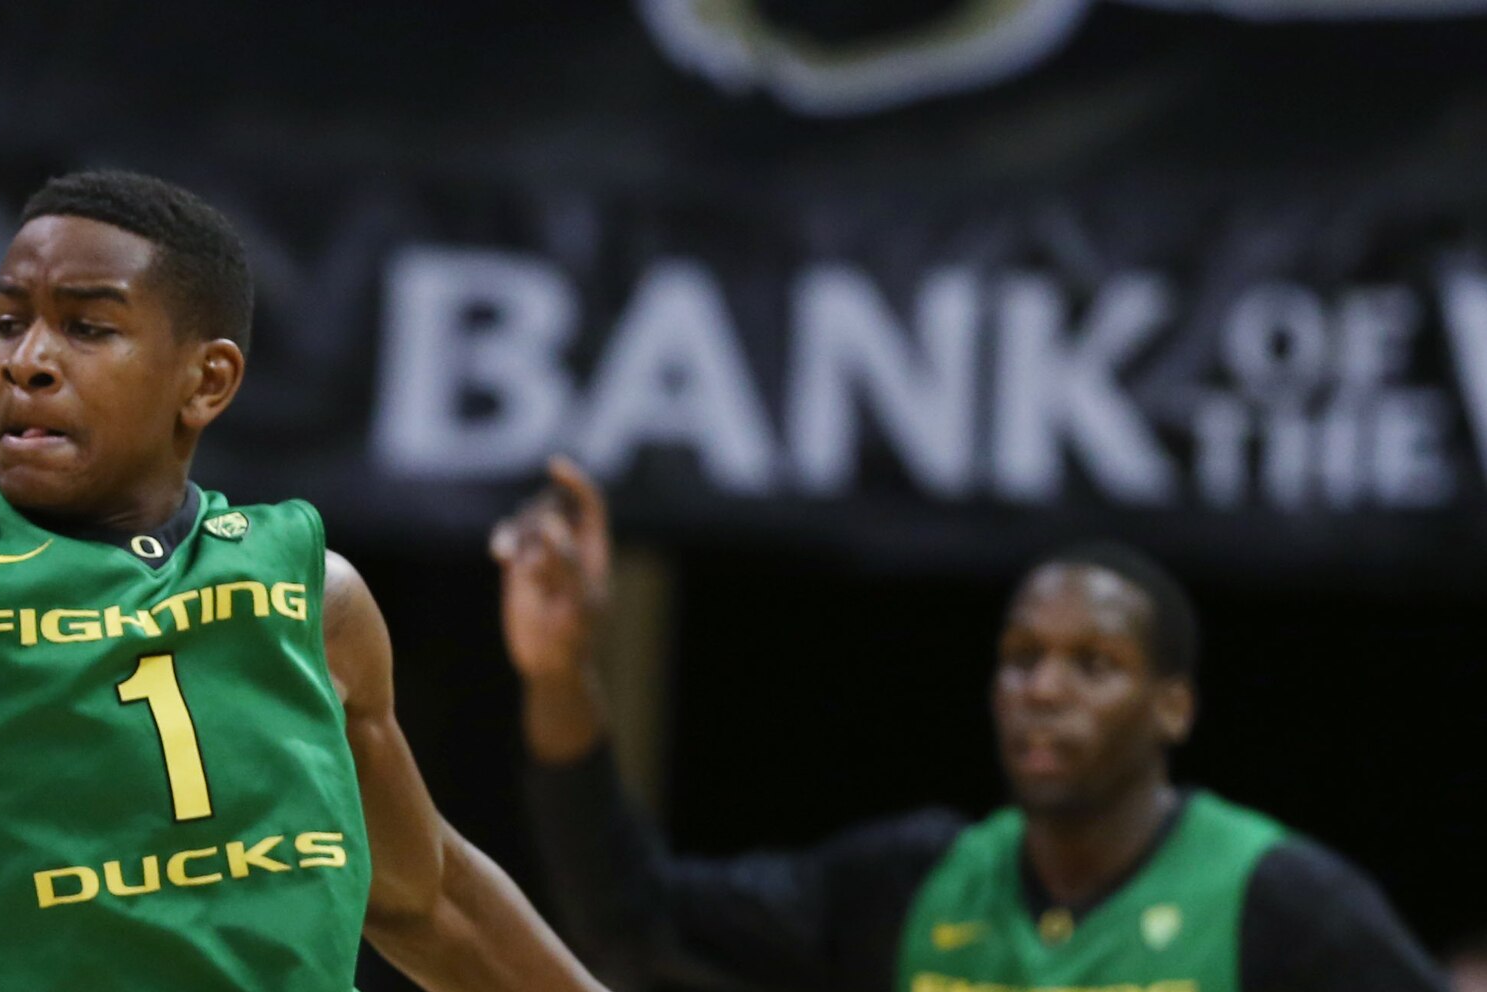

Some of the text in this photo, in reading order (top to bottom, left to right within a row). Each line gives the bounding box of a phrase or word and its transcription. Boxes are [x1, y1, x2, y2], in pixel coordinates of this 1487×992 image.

[372, 245, 1180, 507] BANK
[1222, 281, 1422, 396] OF
[1192, 392, 1454, 512] THE
[115, 652, 214, 823] 1
[33, 831, 347, 909] DUCKS
